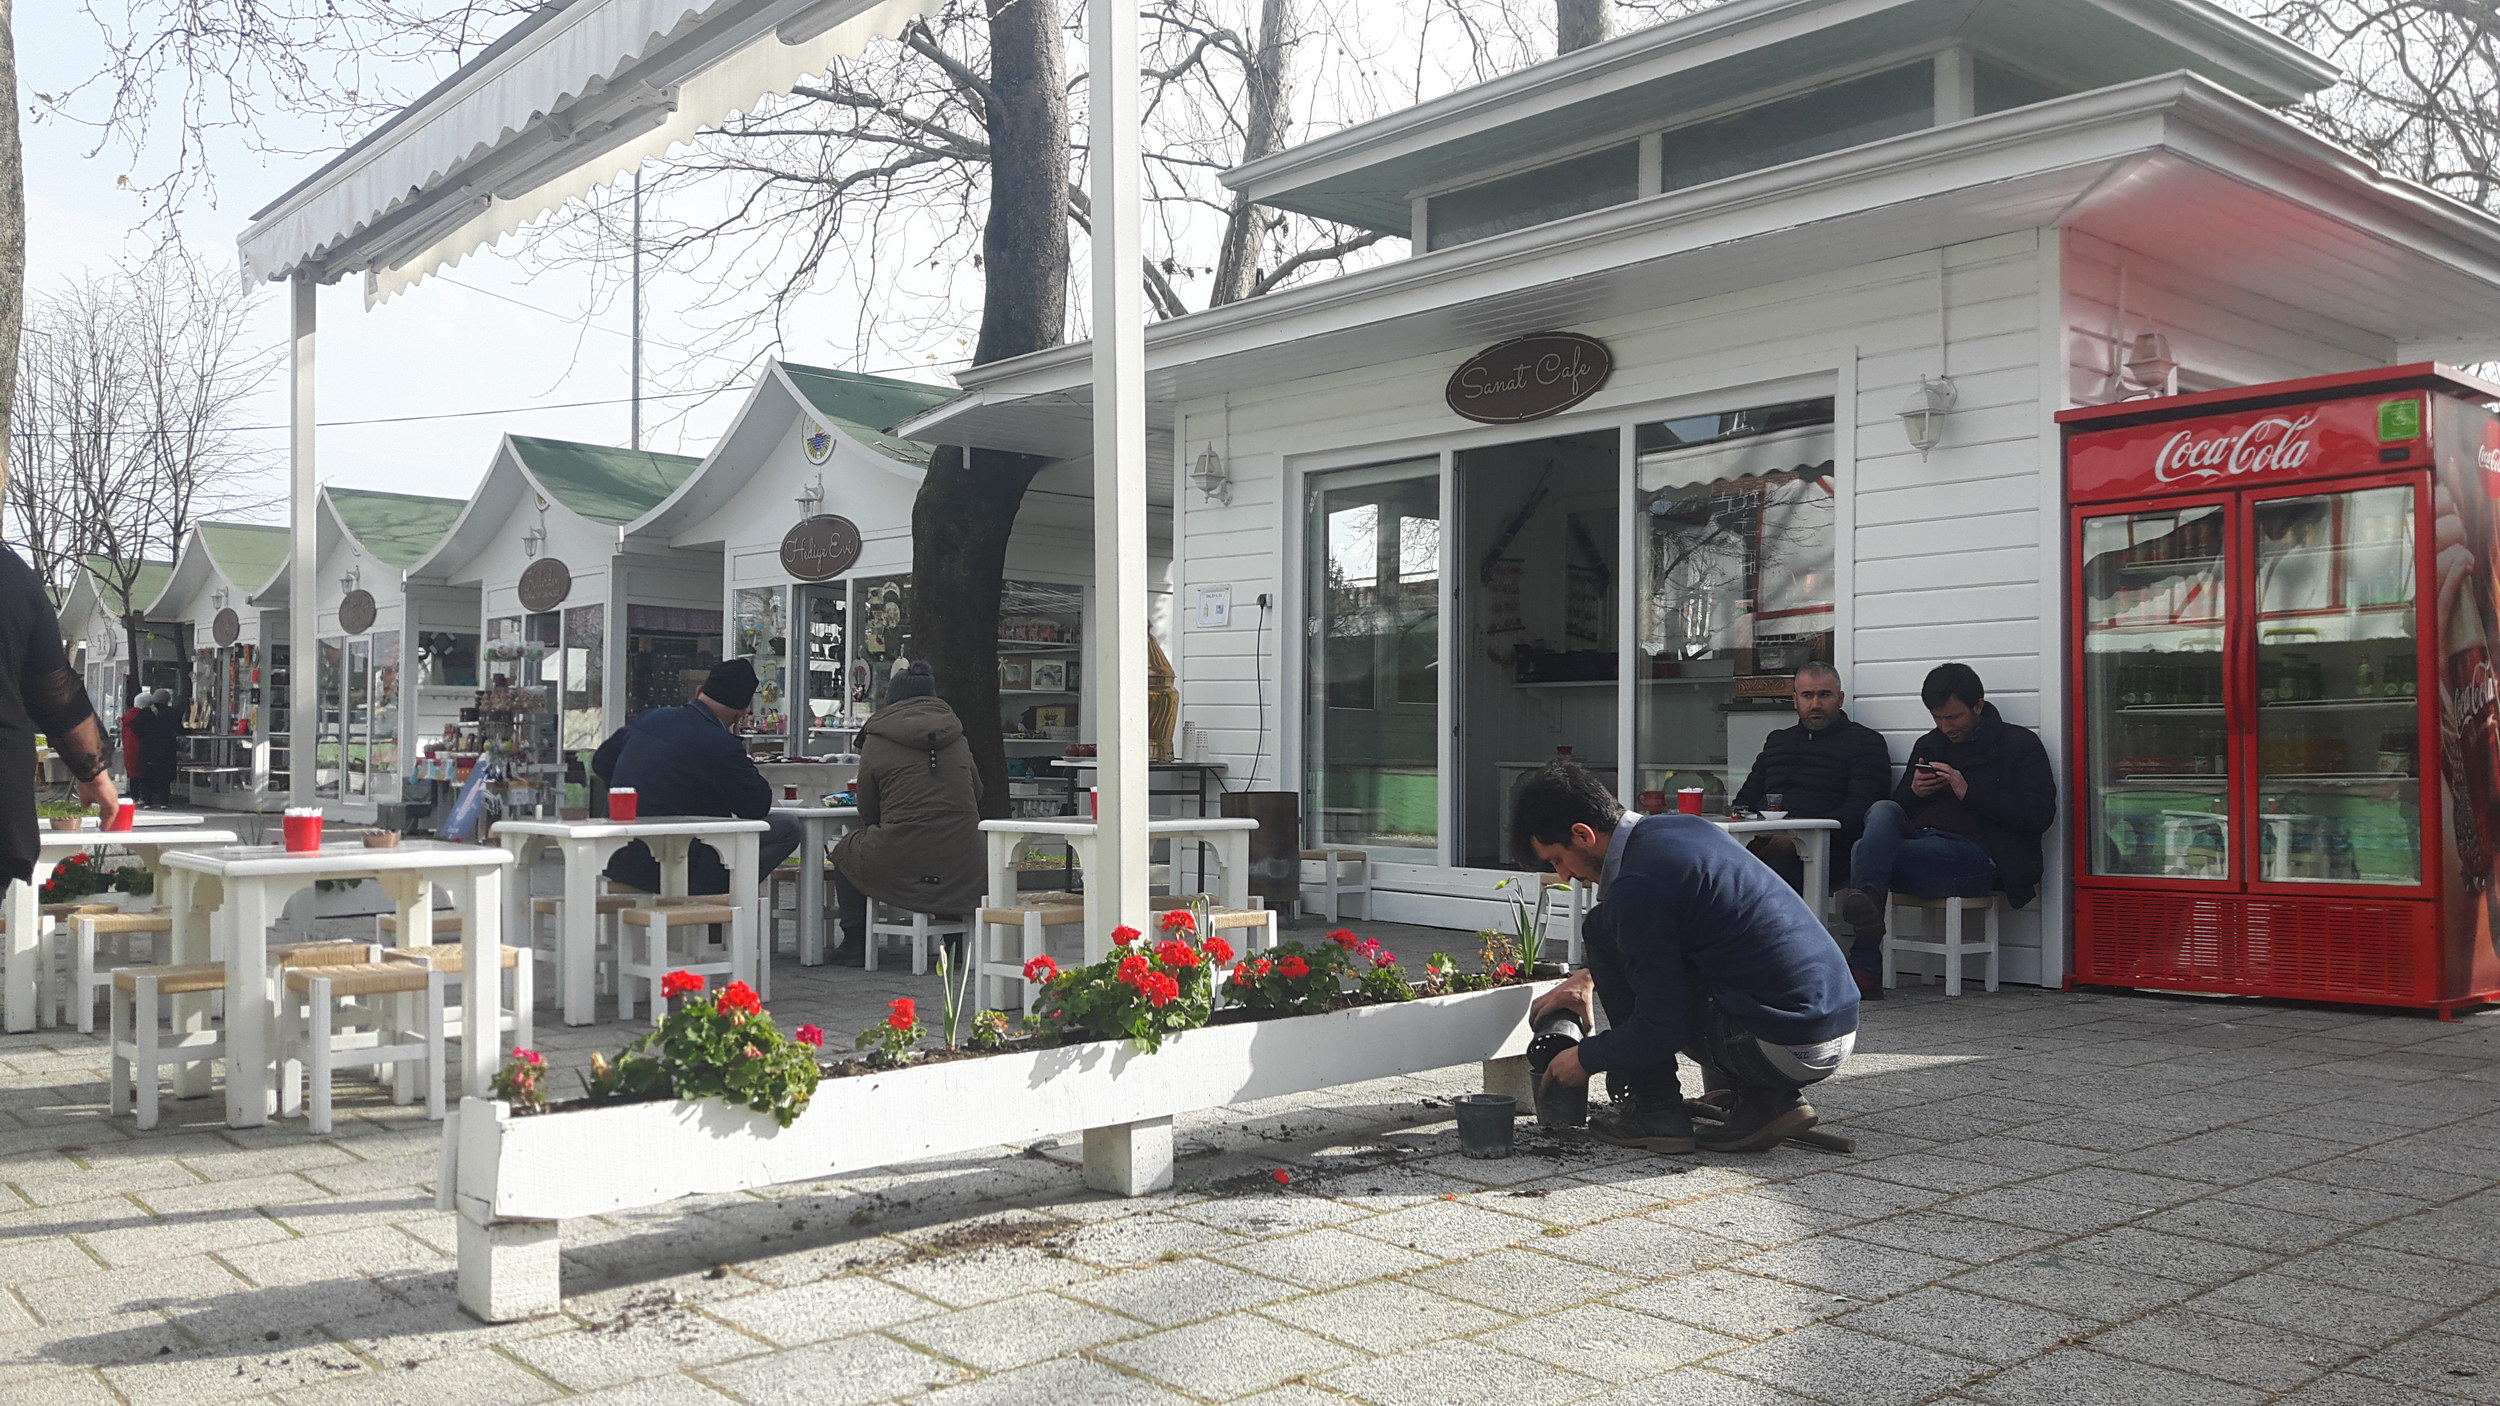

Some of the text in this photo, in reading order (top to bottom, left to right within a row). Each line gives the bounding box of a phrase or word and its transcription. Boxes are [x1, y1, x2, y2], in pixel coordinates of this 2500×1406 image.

[1461, 345, 1591, 398] Sanat Cafe
[2155, 415, 2320, 482] Coca-Cola
[785, 532, 854, 572] Hediye Evi
